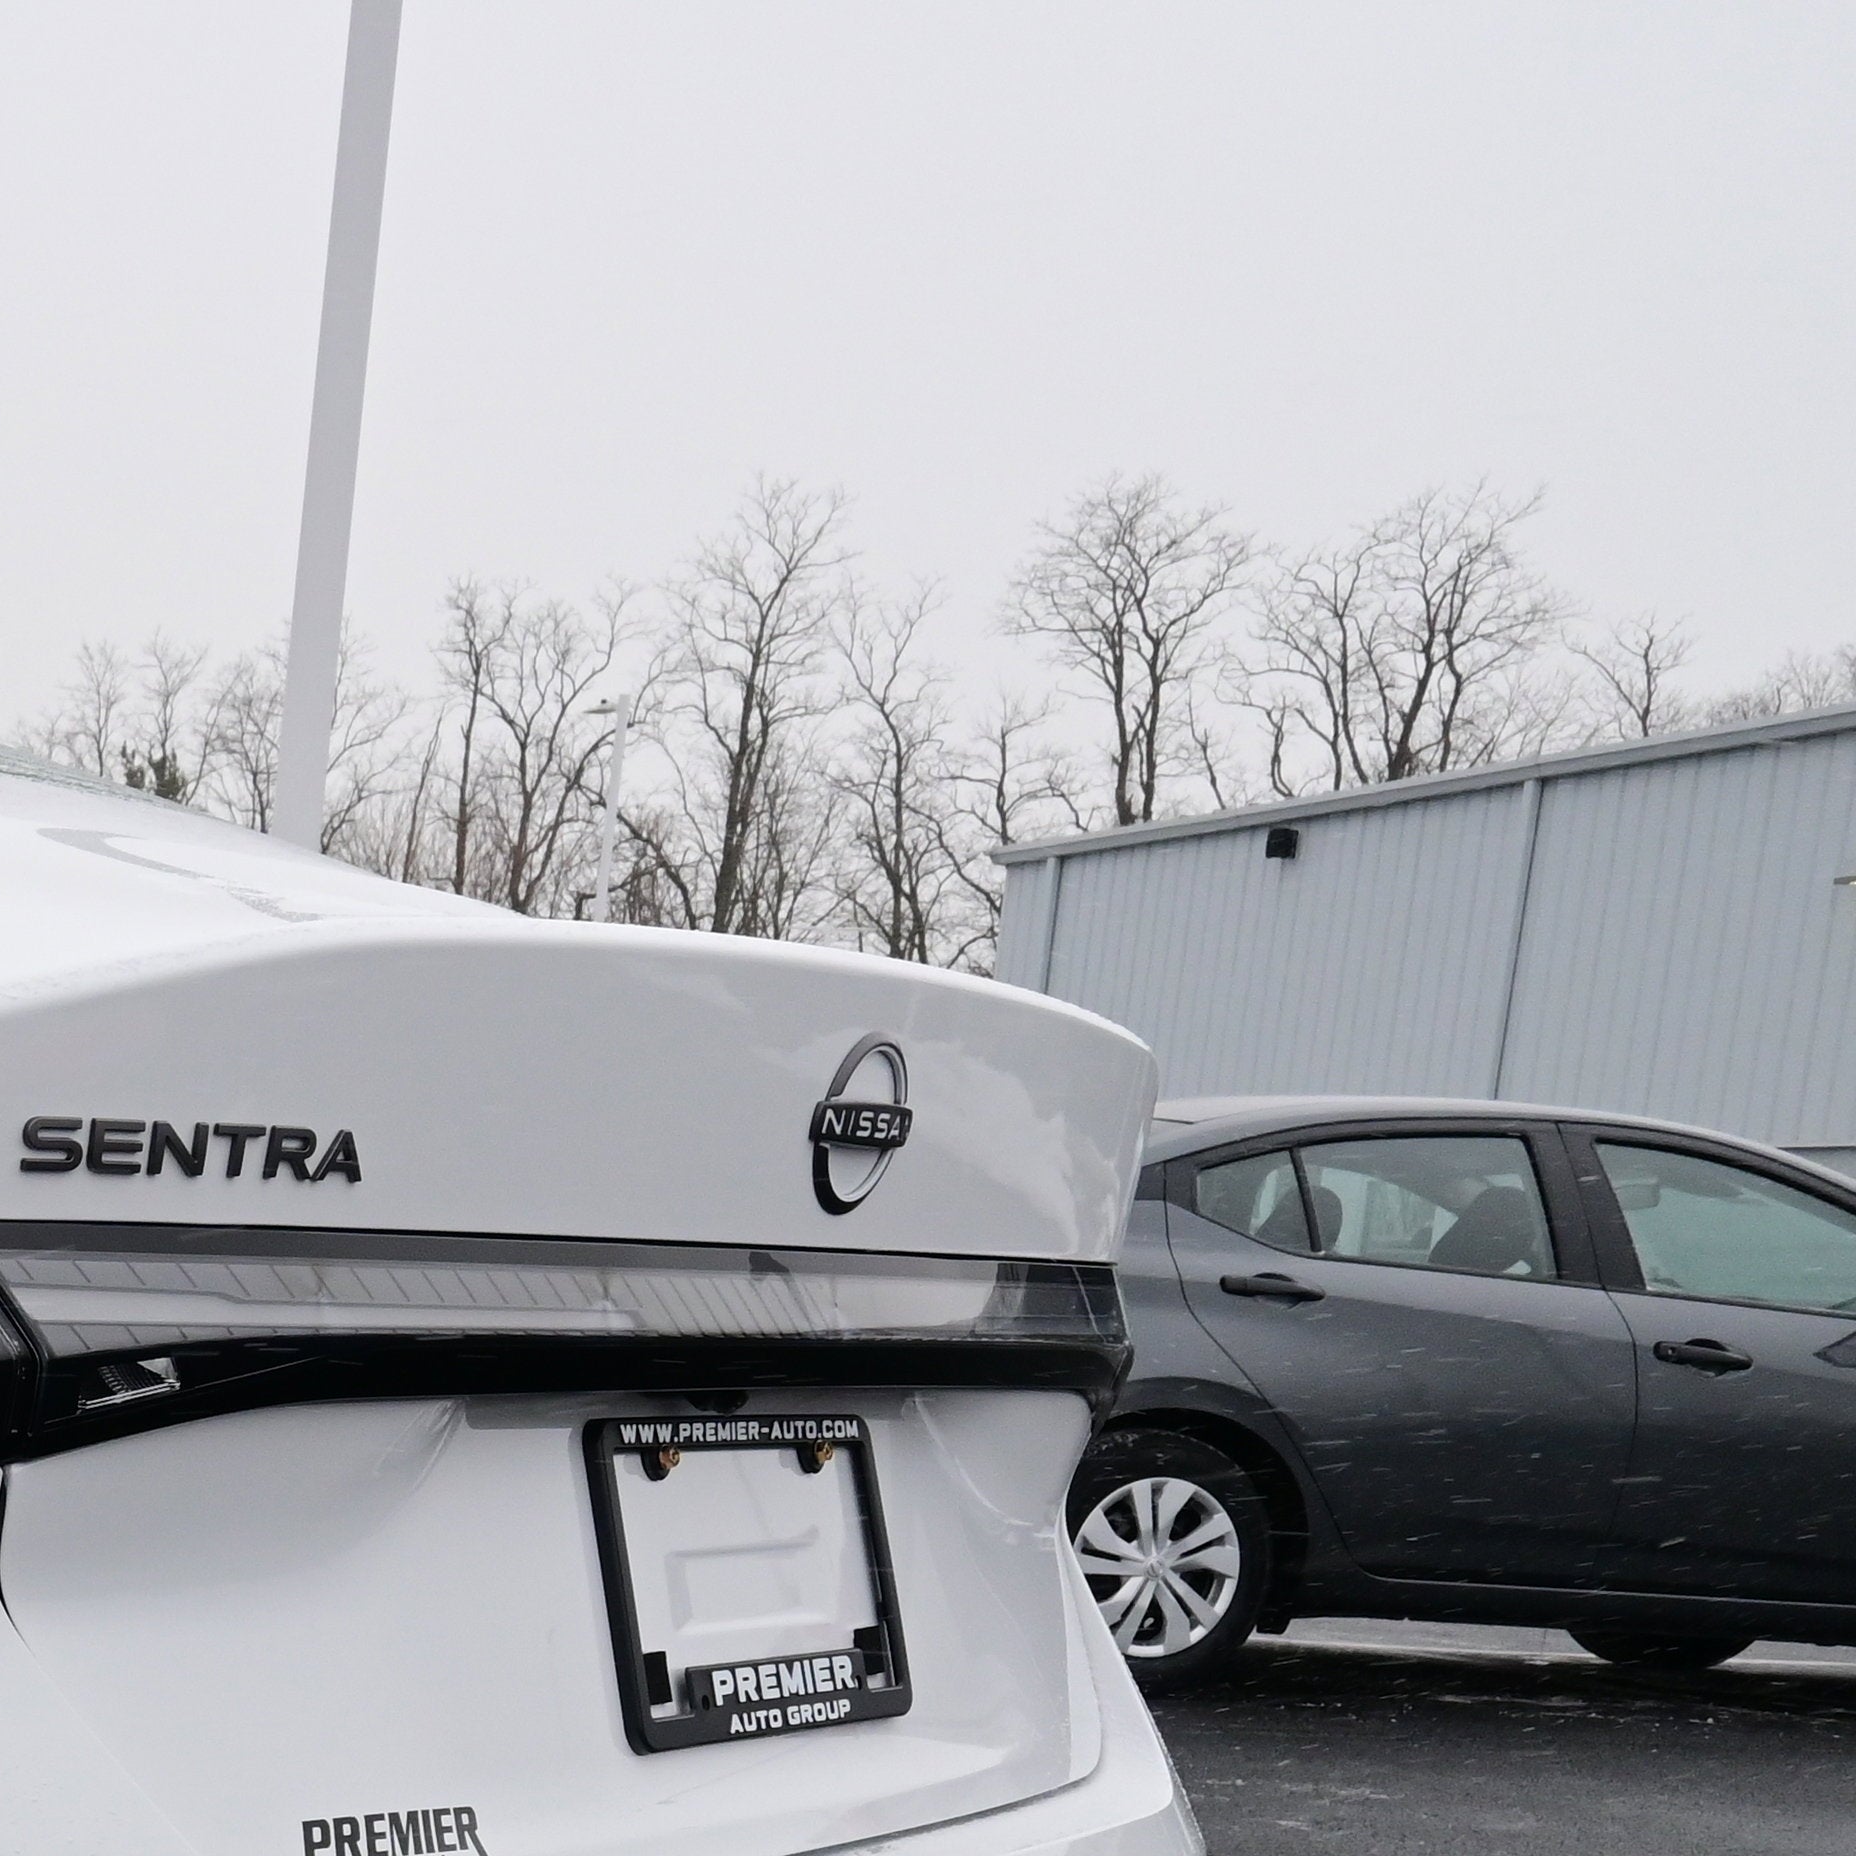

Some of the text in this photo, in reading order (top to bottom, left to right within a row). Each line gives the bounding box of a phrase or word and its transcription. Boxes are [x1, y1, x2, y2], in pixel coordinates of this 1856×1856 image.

[19, 1115, 363, 1183] SENTRA
[619, 1420, 859, 1444] WWW.PREMIER-AUTO.COM
[712, 1655, 855, 1706] PREMIER
[730, 1700, 851, 1734] AUTO GROUP
